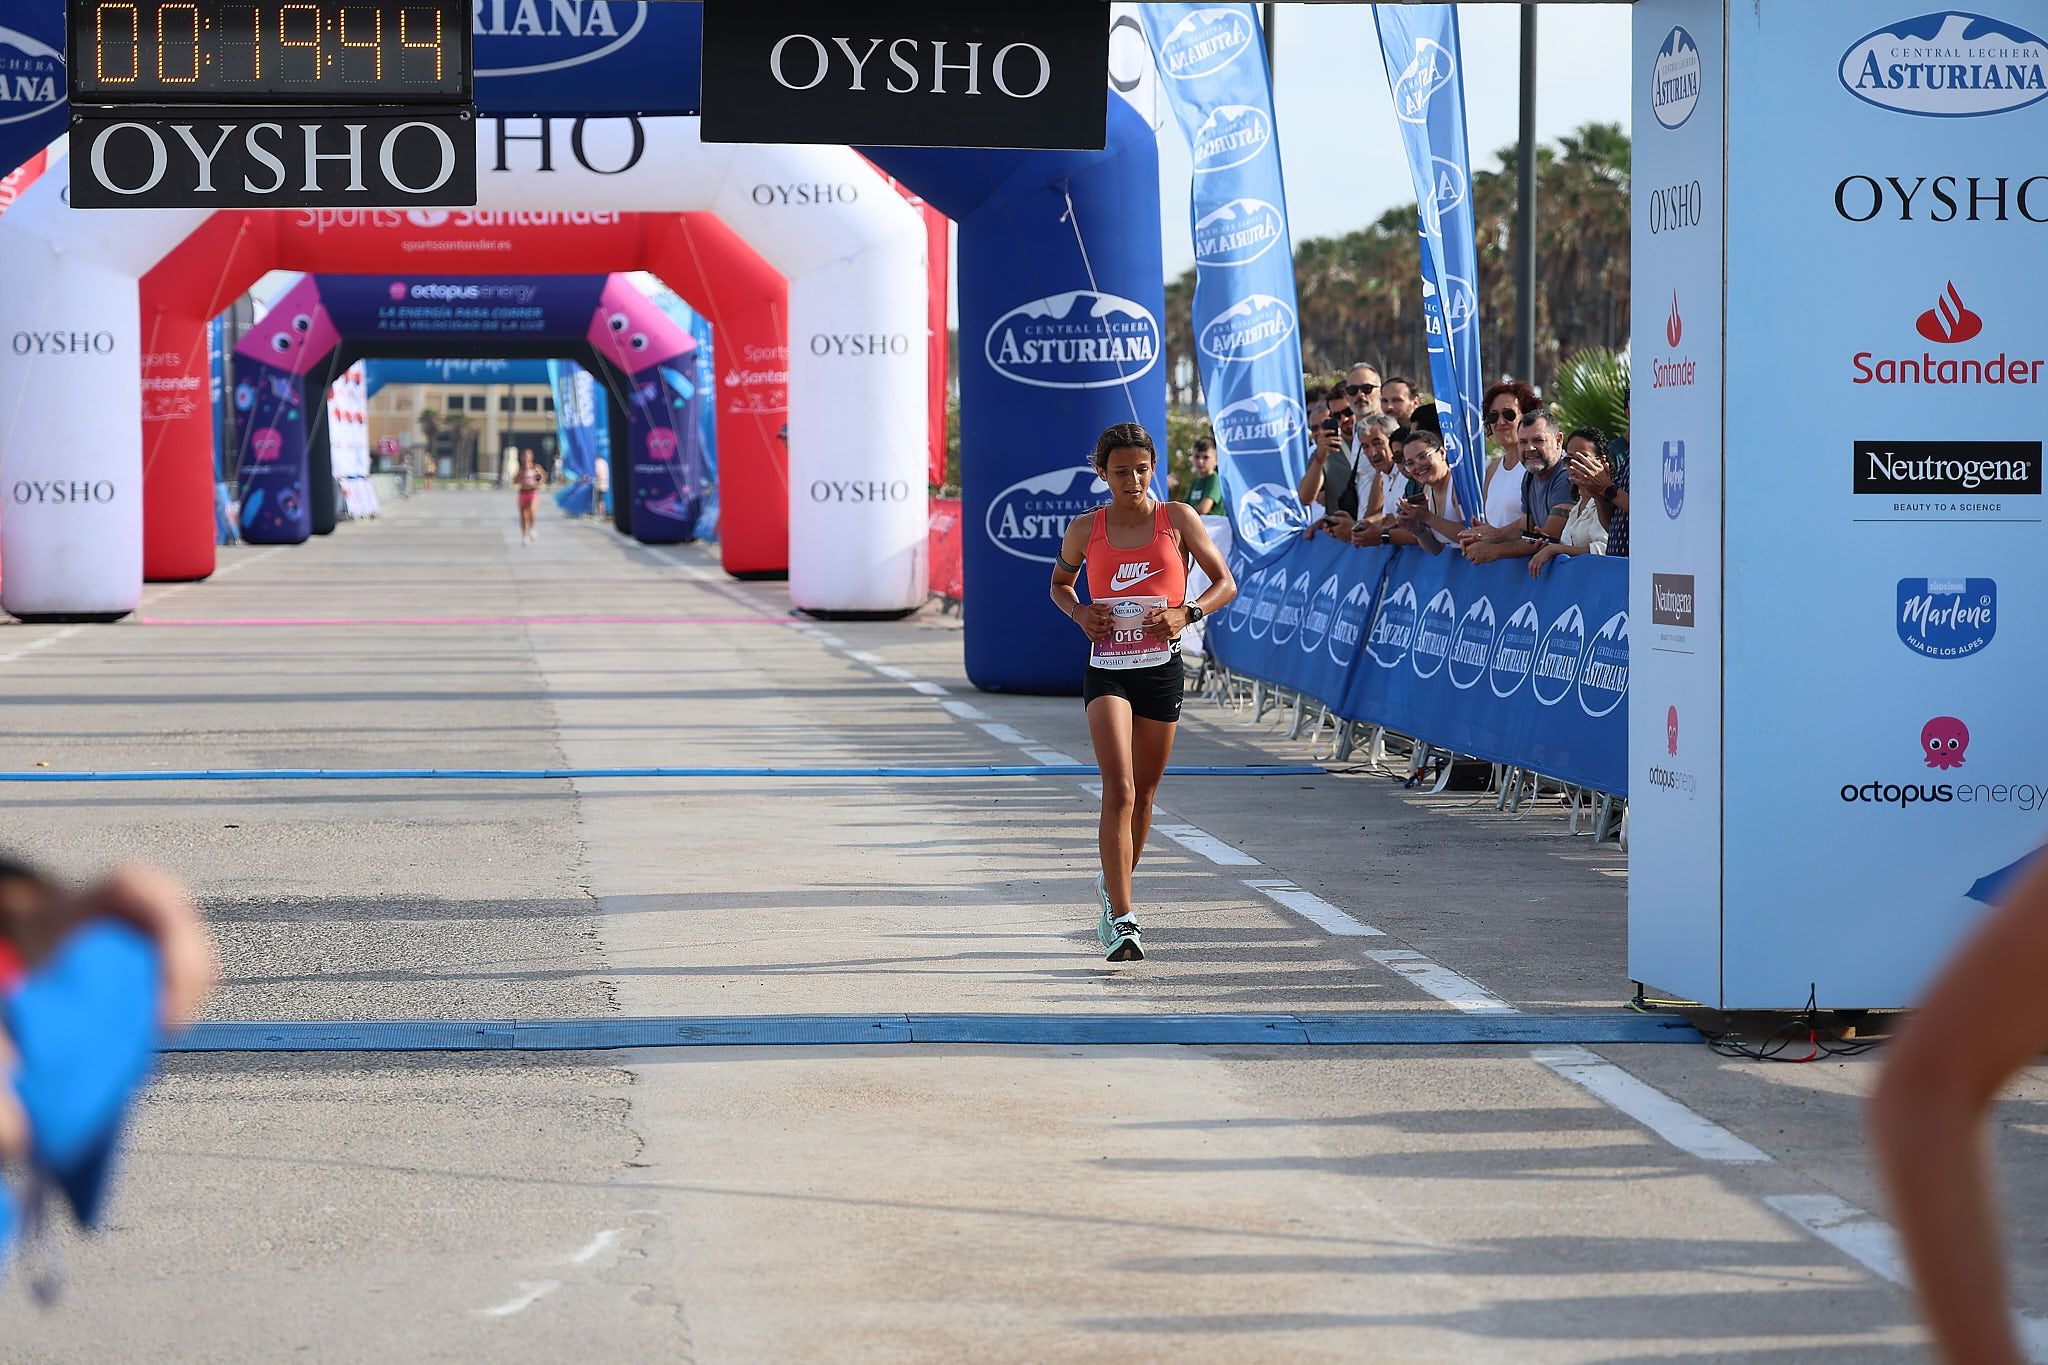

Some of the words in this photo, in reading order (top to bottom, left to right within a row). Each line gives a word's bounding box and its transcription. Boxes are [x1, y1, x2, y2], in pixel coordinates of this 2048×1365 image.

[95, 3, 441, 83] 00:19:44
[1890, 48, 1961, 58] CENTRAL
[1968, 48, 2040, 58] LECHERA
[770, 33, 1051, 98] OYSHO
[1855, 49, 2047, 90] ASTURIANA
[1655, 69, 1697, 108] ASTURIANA
[90, 121, 457, 195] OYSHO
[753, 183, 859, 206] OYSHO
[1650, 180, 1701, 234] OYSHO
[1834, 175, 2048, 222] OYSHO
[13, 331, 114, 356] OYSHO
[1024, 323, 1091, 335] CENTRAL
[1096, 321, 1150, 334] LECHERA
[810, 333, 909, 356] OYSHO
[997, 327, 1153, 364] ASTURIANA
[1653, 356, 1696, 388] Santander
[1852, 352, 2045, 384] Santander
[1866, 452, 2028, 489] Neutrogena
[13, 480, 114, 504] OYSHO
[810, 480, 910, 504] OYSHO
[1024, 499, 1089, 511] CENTRAL
[1893, 503, 1931, 511] BEAUTY
[1935, 503, 1947, 511] TO
[1950, 503, 1956, 511] A
[1959, 503, 2002, 511] SCIENCE
[1116, 561, 1151, 579] NIKE
[1655, 584, 1692, 620] Neutrogena
[1115, 628, 1144, 643] 016
[1907, 635, 1924, 651] HIJA
[1927, 645, 1938, 655] DE
[1940, 646, 1957, 655] LOS
[1958, 637, 1984, 654] ALPES
[1581, 646, 1628, 692] ASTURIANA
[1649, 764, 1675, 792] octopus
[1840, 780, 1954, 809] octopus
[1956, 784, 2048, 811] energy
